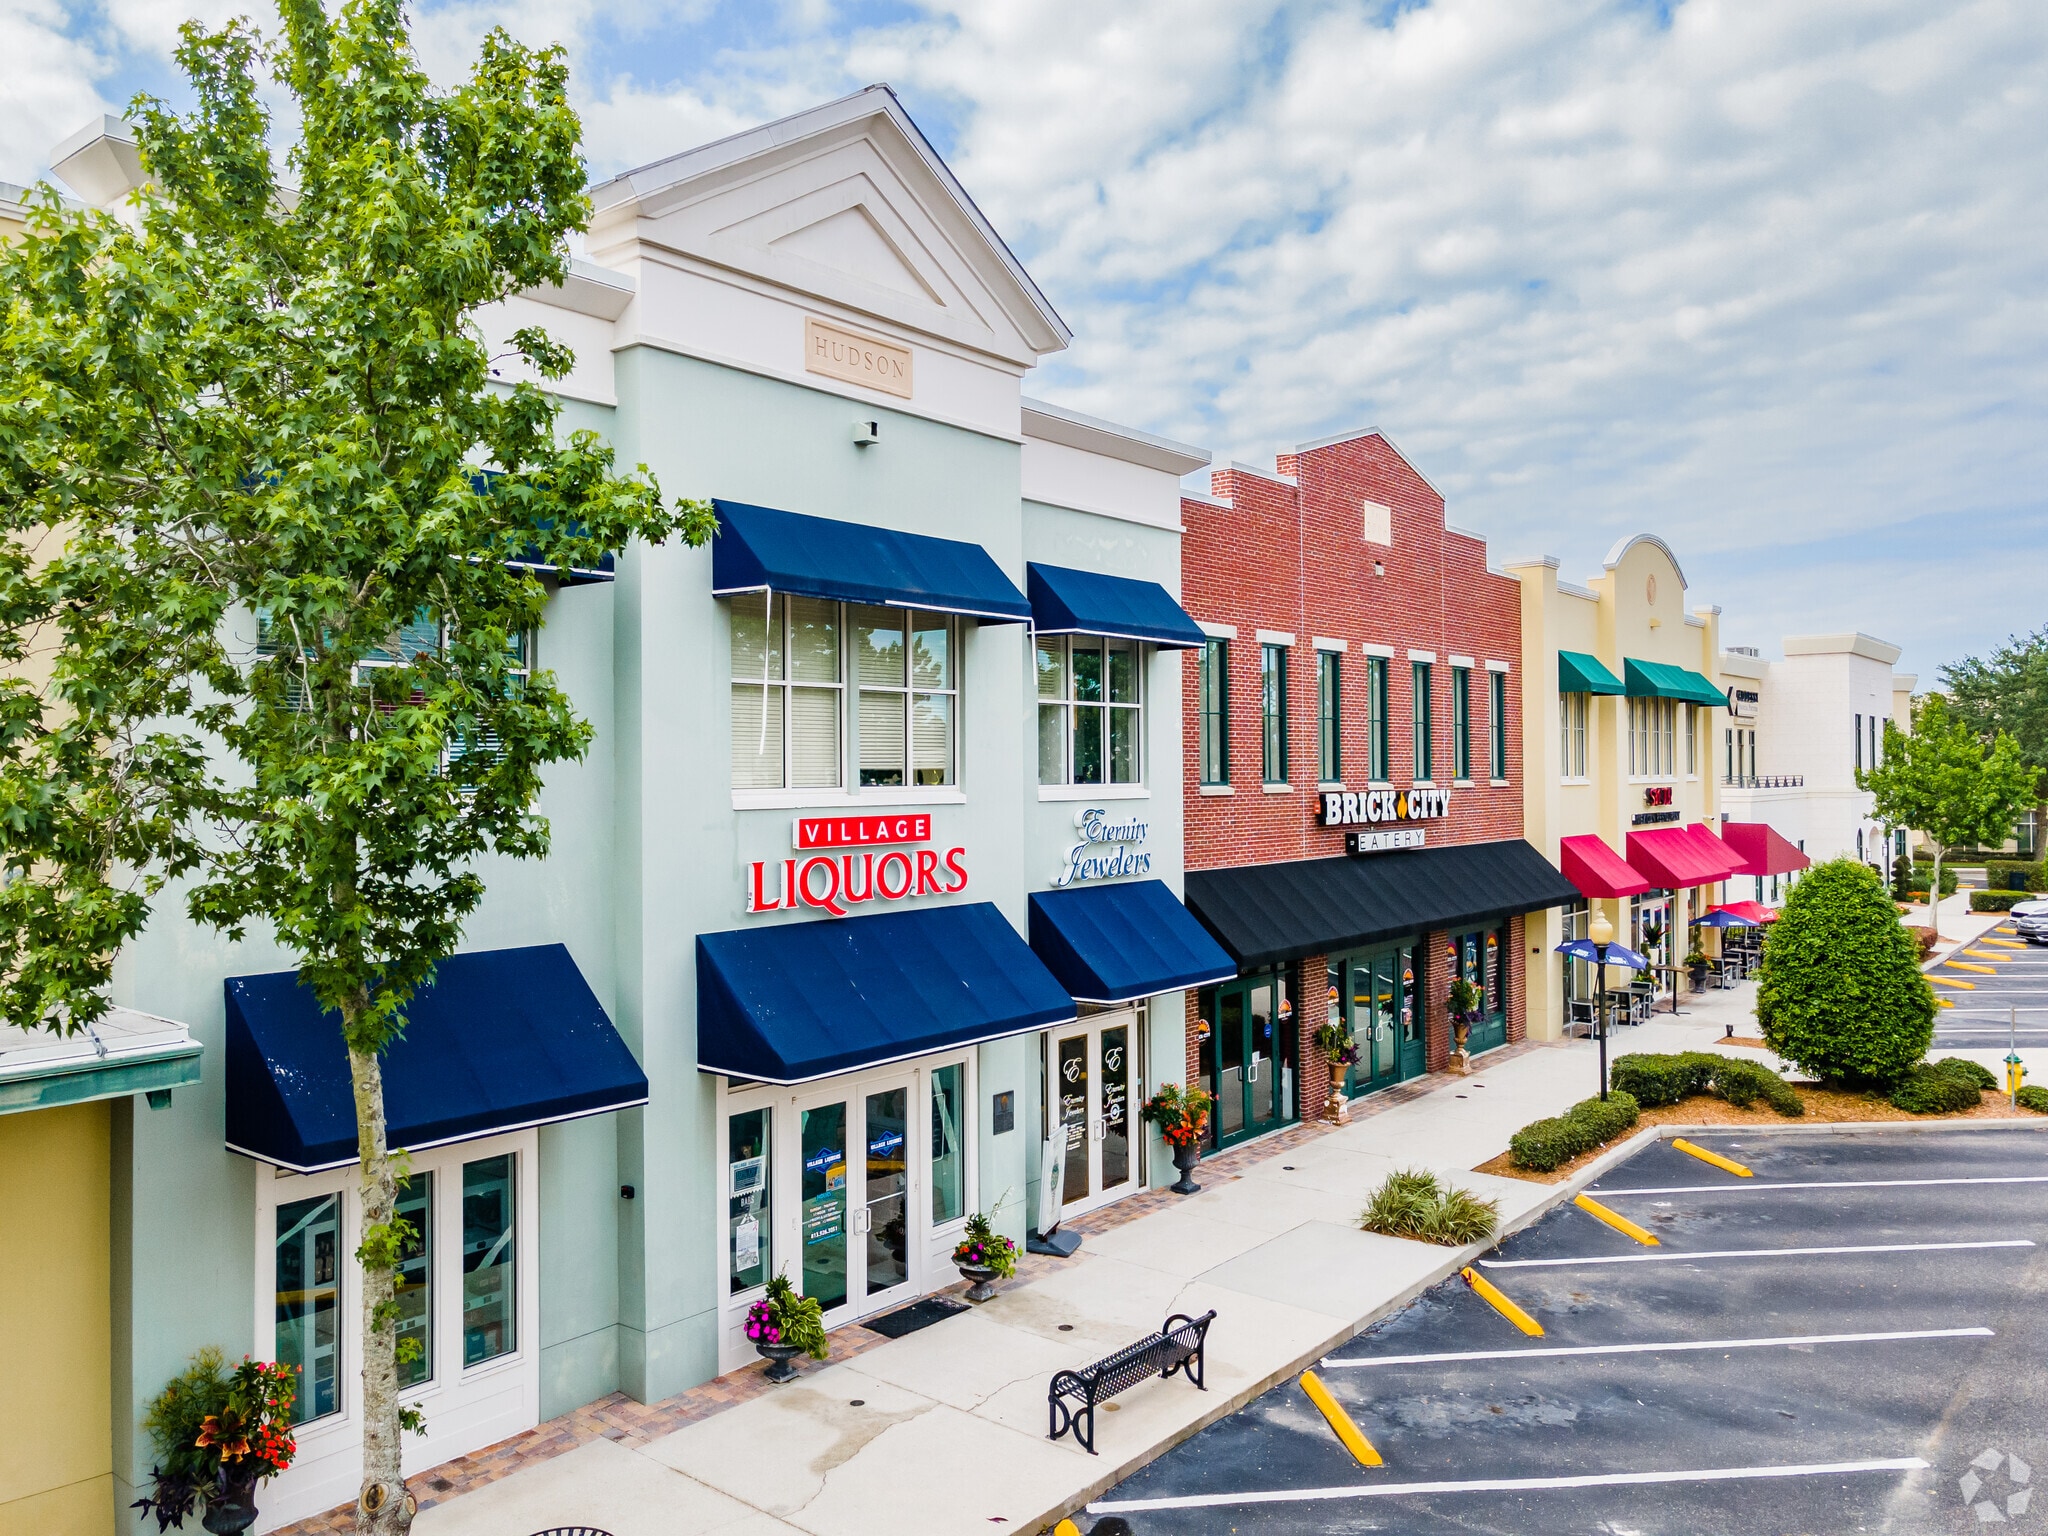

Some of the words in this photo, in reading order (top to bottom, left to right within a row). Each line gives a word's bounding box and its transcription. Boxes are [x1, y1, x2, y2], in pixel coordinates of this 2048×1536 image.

[815, 335, 904, 378] HUDSON
[1079, 807, 1150, 845] Eternity
[1325, 790, 1397, 826] BRICK
[1407, 789, 1451, 820] CITY
[804, 818, 926, 844] VILLAGE
[1360, 831, 1423, 851] EATERY
[748, 847, 968, 917] LIQUORS
[1057, 841, 1151, 888] Jewelers
